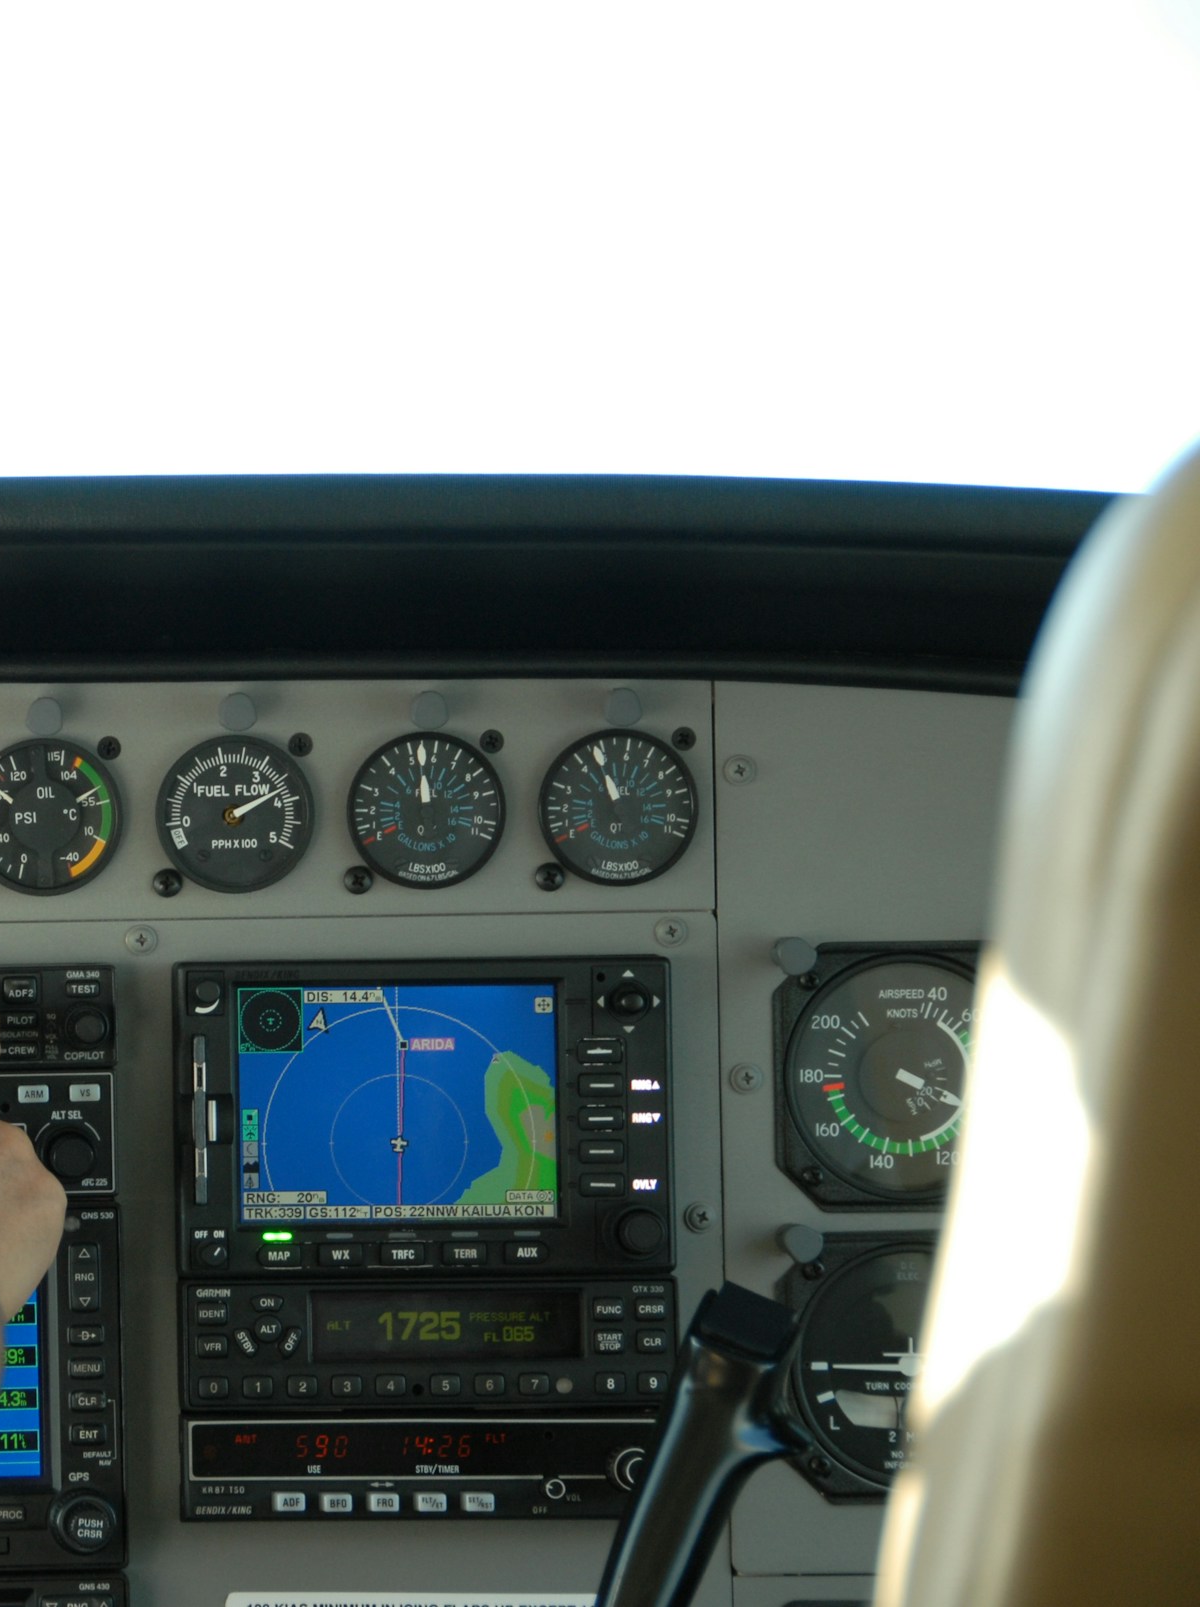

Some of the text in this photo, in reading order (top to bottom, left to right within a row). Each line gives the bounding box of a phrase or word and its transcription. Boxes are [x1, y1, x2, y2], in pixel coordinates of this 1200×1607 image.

[48, 752, 60, 762] 115
[11, 771, 26, 781] 120
[61, 771, 77, 780] 104
[37, 787, 55, 799] OIL
[198, 784, 270, 797] FUEL FLOW
[15, 812, 37, 824] PSI
[85, 827, 93, 836] 10
[174, 830, 186, 846] OFF
[60, 852, 79, 862] -40
[9, 989, 33, 997] ADF2
[71, 985, 96, 994] TEST
[879, 989, 924, 999] AIRSPEED
[928, 987, 947, 1000] 40
[307, 992, 333, 1002] DIS:
[886, 1008, 918, 1019] KNOTS
[7, 1016, 33, 1024] PILOT
[812, 1016, 840, 1029] 200
[411, 1040, 455, 1050] ARIDA
[64, 1052, 104, 1060] COPILOT
[800, 1070, 824, 1083] 180
[25, 1090, 44, 1099] ARM
[80, 1089, 91, 1097] VS
[51, 1110, 83, 1120] ALT SEL
[815, 1123, 840, 1136] 160
[870, 1155, 894, 1169] 140
[246, 1193, 280, 1203] RNG:
[509, 1192, 533, 1200] DATA
[375, 1205, 545, 1218] POS: 22NNW KAILUA KON
[195, 1230, 225, 1239] OFF ON
[268, 1252, 290, 1261] MAP
[332, 1250, 350, 1260] WX
[392, 1250, 415, 1260] TRFC
[454, 1249, 477, 1259] TERR
[517, 1248, 538, 1258] AUX
[75, 1273, 95, 1281] RNG
[196, 1289, 231, 1298] GARMIN
[632, 1285, 664, 1293] GTX 330
[260, 1299, 275, 1307] ON
[596, 1305, 622, 1314] FUNC
[639, 1305, 664, 1313] CRSR
[200, 1310, 225, 1318] IDENT
[469, 1312, 550, 1321] PRESSURE ALT
[260, 1325, 277, 1334] ALT
[378, 1311, 461, 1341] 1725
[502, 1326, 535, 1342] 065
[598, 1333, 622, 1341] START
[204, 1343, 222, 1351] VFR
[236, 1331, 255, 1354] STBY
[284, 1333, 299, 1352] OFF
[600, 1343, 621, 1351] STOP
[643, 1338, 662, 1347] CLR
[73, 1364, 100, 1372] MENU
[865, 1382, 889, 1390] TURN
[78, 1398, 97, 1406] CLR
[79, 1431, 98, 1439] ENT
[235, 1434, 257, 1444] ANT
[296, 1435, 349, 1458] 590
[307, 1465, 321, 1474] USE
[415, 1465, 460, 1474] STBY/TIMER
[69, 1472, 89, 1482] GPS
[282, 1499, 300, 1507] ADF
[330, 1499, 347, 1508] BFO
[377, 1499, 394, 1507] FRQ
[78, 1519, 103, 1529] PUSH
[77, 1529, 102, 1539] CRSR
